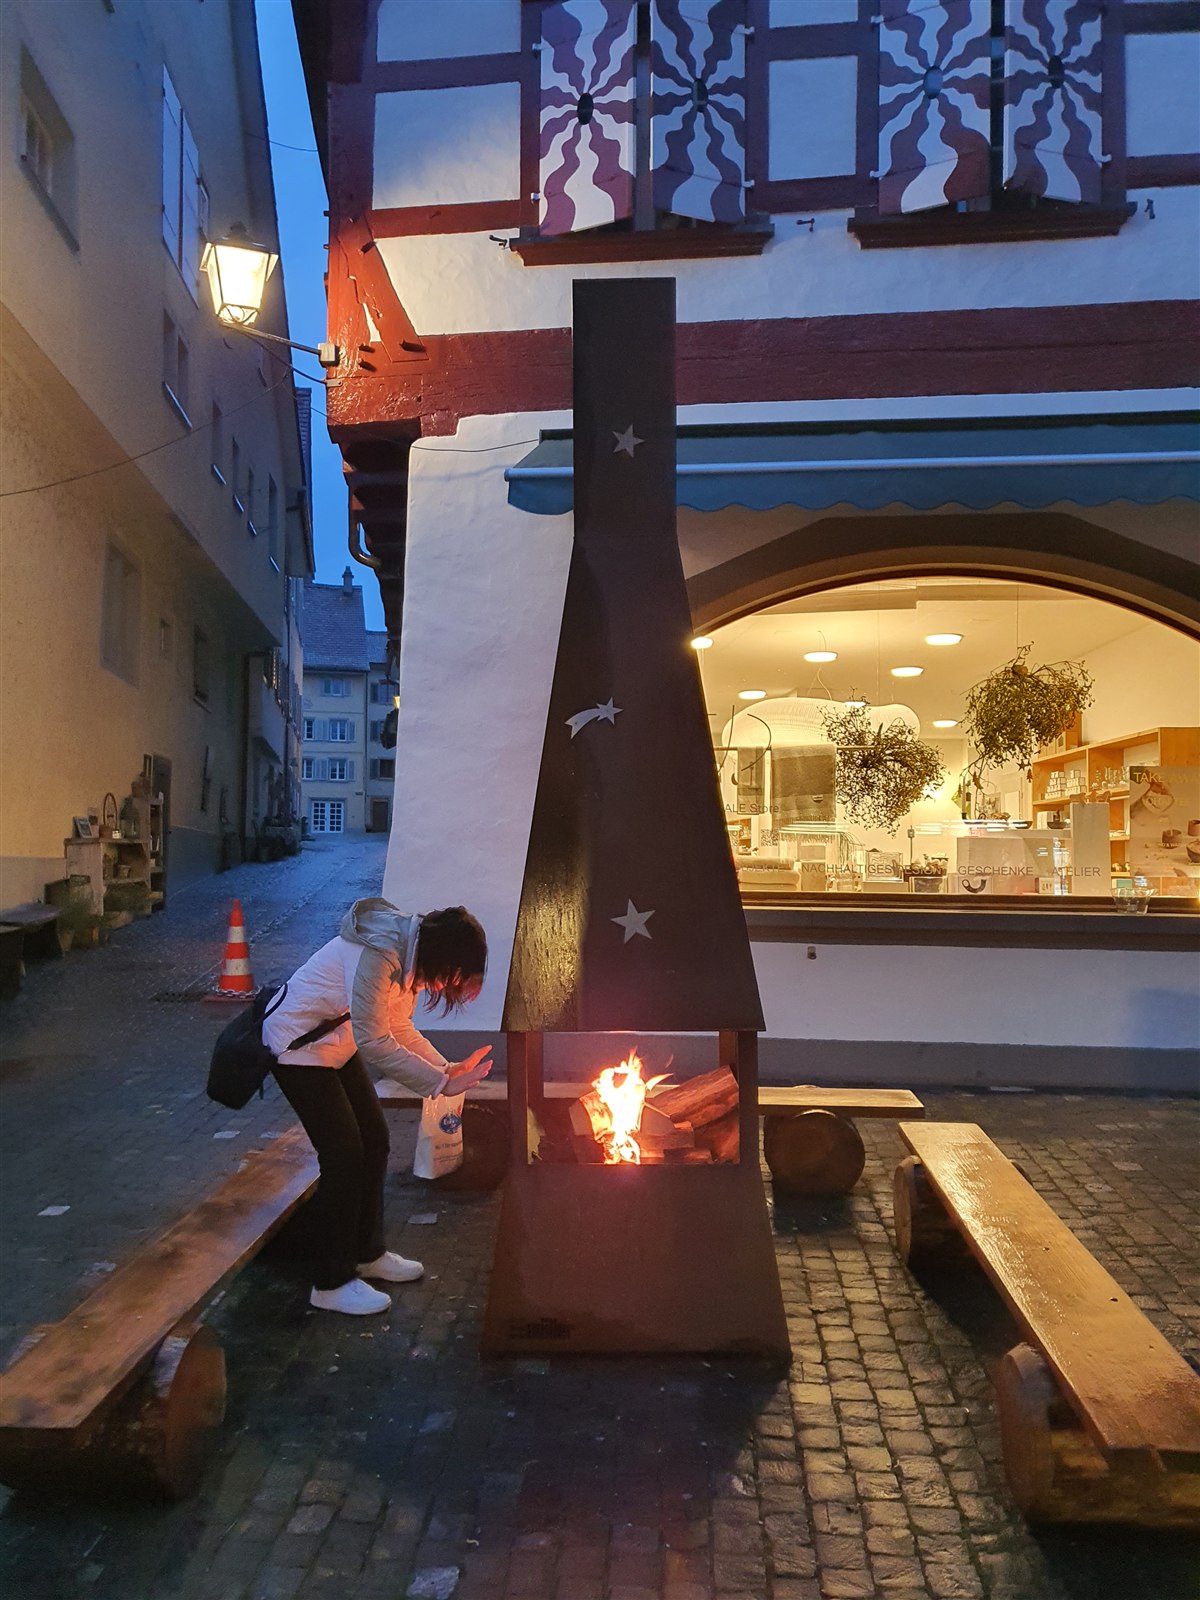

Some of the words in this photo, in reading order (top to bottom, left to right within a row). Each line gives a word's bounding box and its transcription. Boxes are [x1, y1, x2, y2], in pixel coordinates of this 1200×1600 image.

[725, 803, 745, 813] ALE
[749, 803, 780, 813] Store
[801, 863, 893, 875] NACHHALTIGES
[899, 864, 942, 876] DESIGN
[957, 865, 1034, 877] GESCHENKE
[1051, 866, 1102, 878] ATELIER
